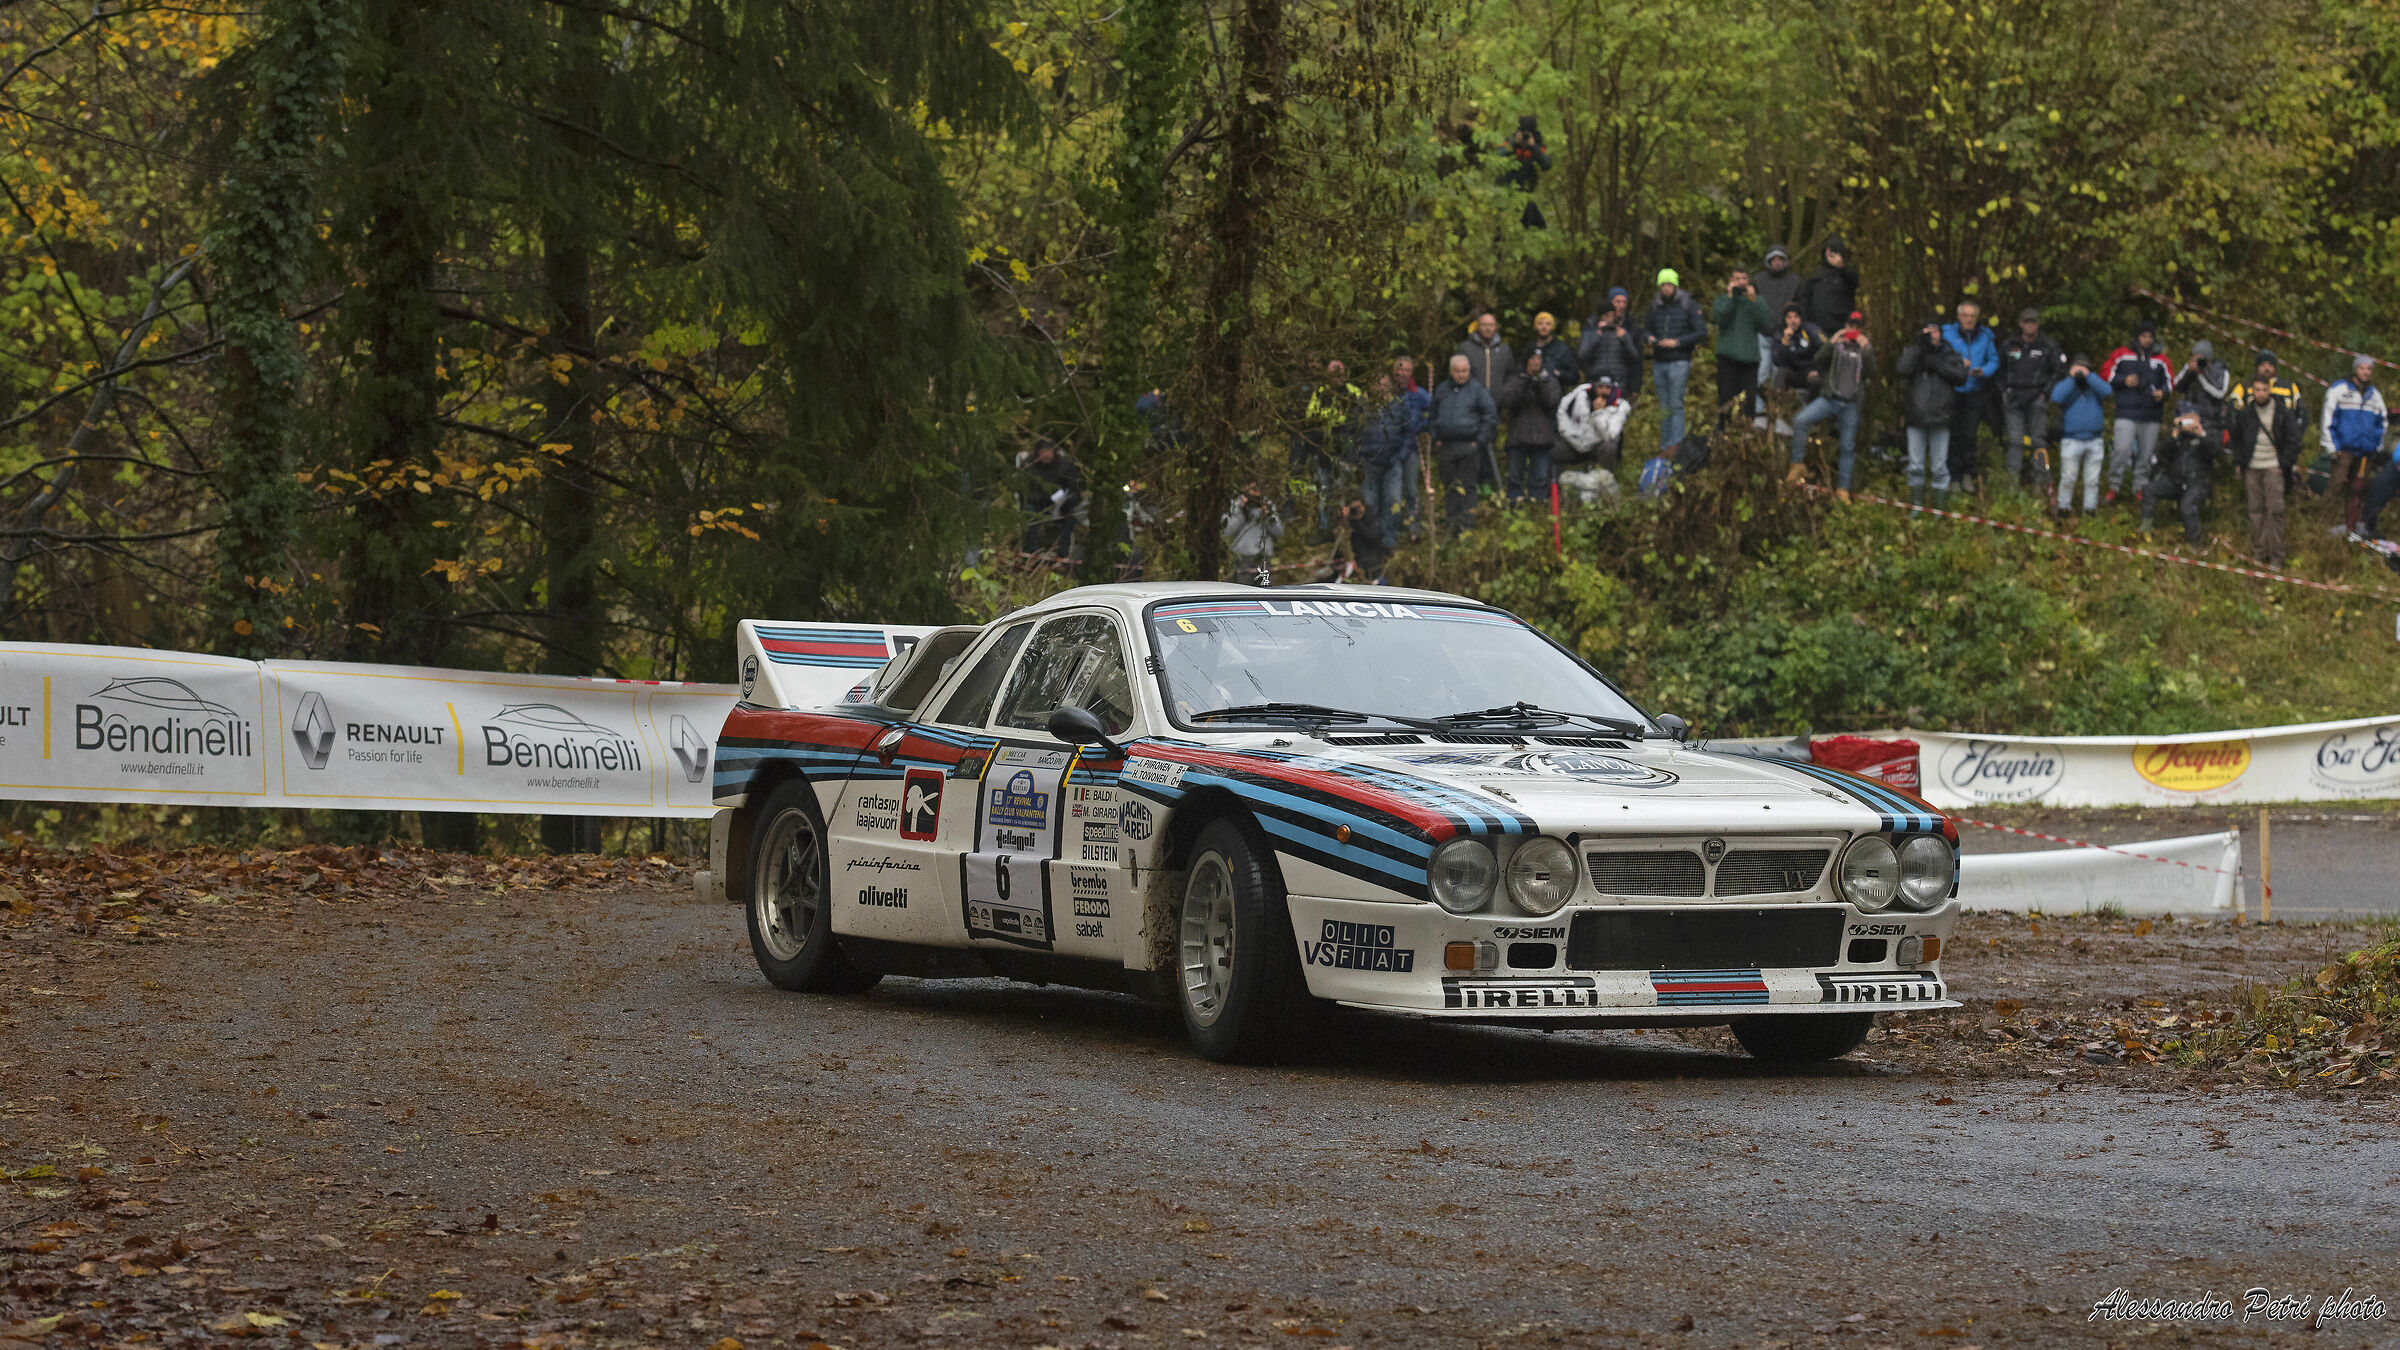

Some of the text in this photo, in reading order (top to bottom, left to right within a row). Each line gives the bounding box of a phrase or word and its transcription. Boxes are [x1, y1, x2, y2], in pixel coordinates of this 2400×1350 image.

[1257, 600, 1424, 619] LANCIA
[1176, 618, 1198, 633] 6
[76, 704, 251, 757] Bendinelli
[346, 723, 445, 745] RENAULT
[348, 748, 422, 763] Passion for life
[482, 725, 641, 771] Bendinelli
[121, 762, 204, 776] www.bendinelli.it
[1176, 766, 1186, 774] B+
[1563, 759, 1640, 772] LANCIA
[527, 776, 600, 790] www.bendinelli.it
[1138, 770, 1169, 784] TOIVONEN
[858, 793, 900, 815] rantasipi
[1014, 796, 1032, 806] REVIVAL
[1093, 791, 1112, 802] BALDI
[992, 806, 1045, 819] RALLY CLUB VALPANTENA
[1119, 800, 1153, 822] MAGNETI
[856, 811, 898, 831] laajavuori
[1119, 819, 1153, 840] MARELLI
[1084, 825, 1119, 840] speedline
[1082, 845, 1118, 862] BILSTEIN
[846, 857, 921, 873] pininfarina
[996, 855, 1011, 901] 6
[1071, 872, 1107, 890] brembo
[858, 886, 908, 908] olivetti
[1074, 899, 1109, 915] FERODO
[1075, 920, 1104, 938] sabelt
[1323, 922, 1392, 946] OLIO
[1517, 927, 1565, 939] SIEM
[1868, 924, 1907, 936] SIEM
[1441, 976, 1598, 1008] PIRELLI
[1814, 971, 1943, 1004] PIRELLI
